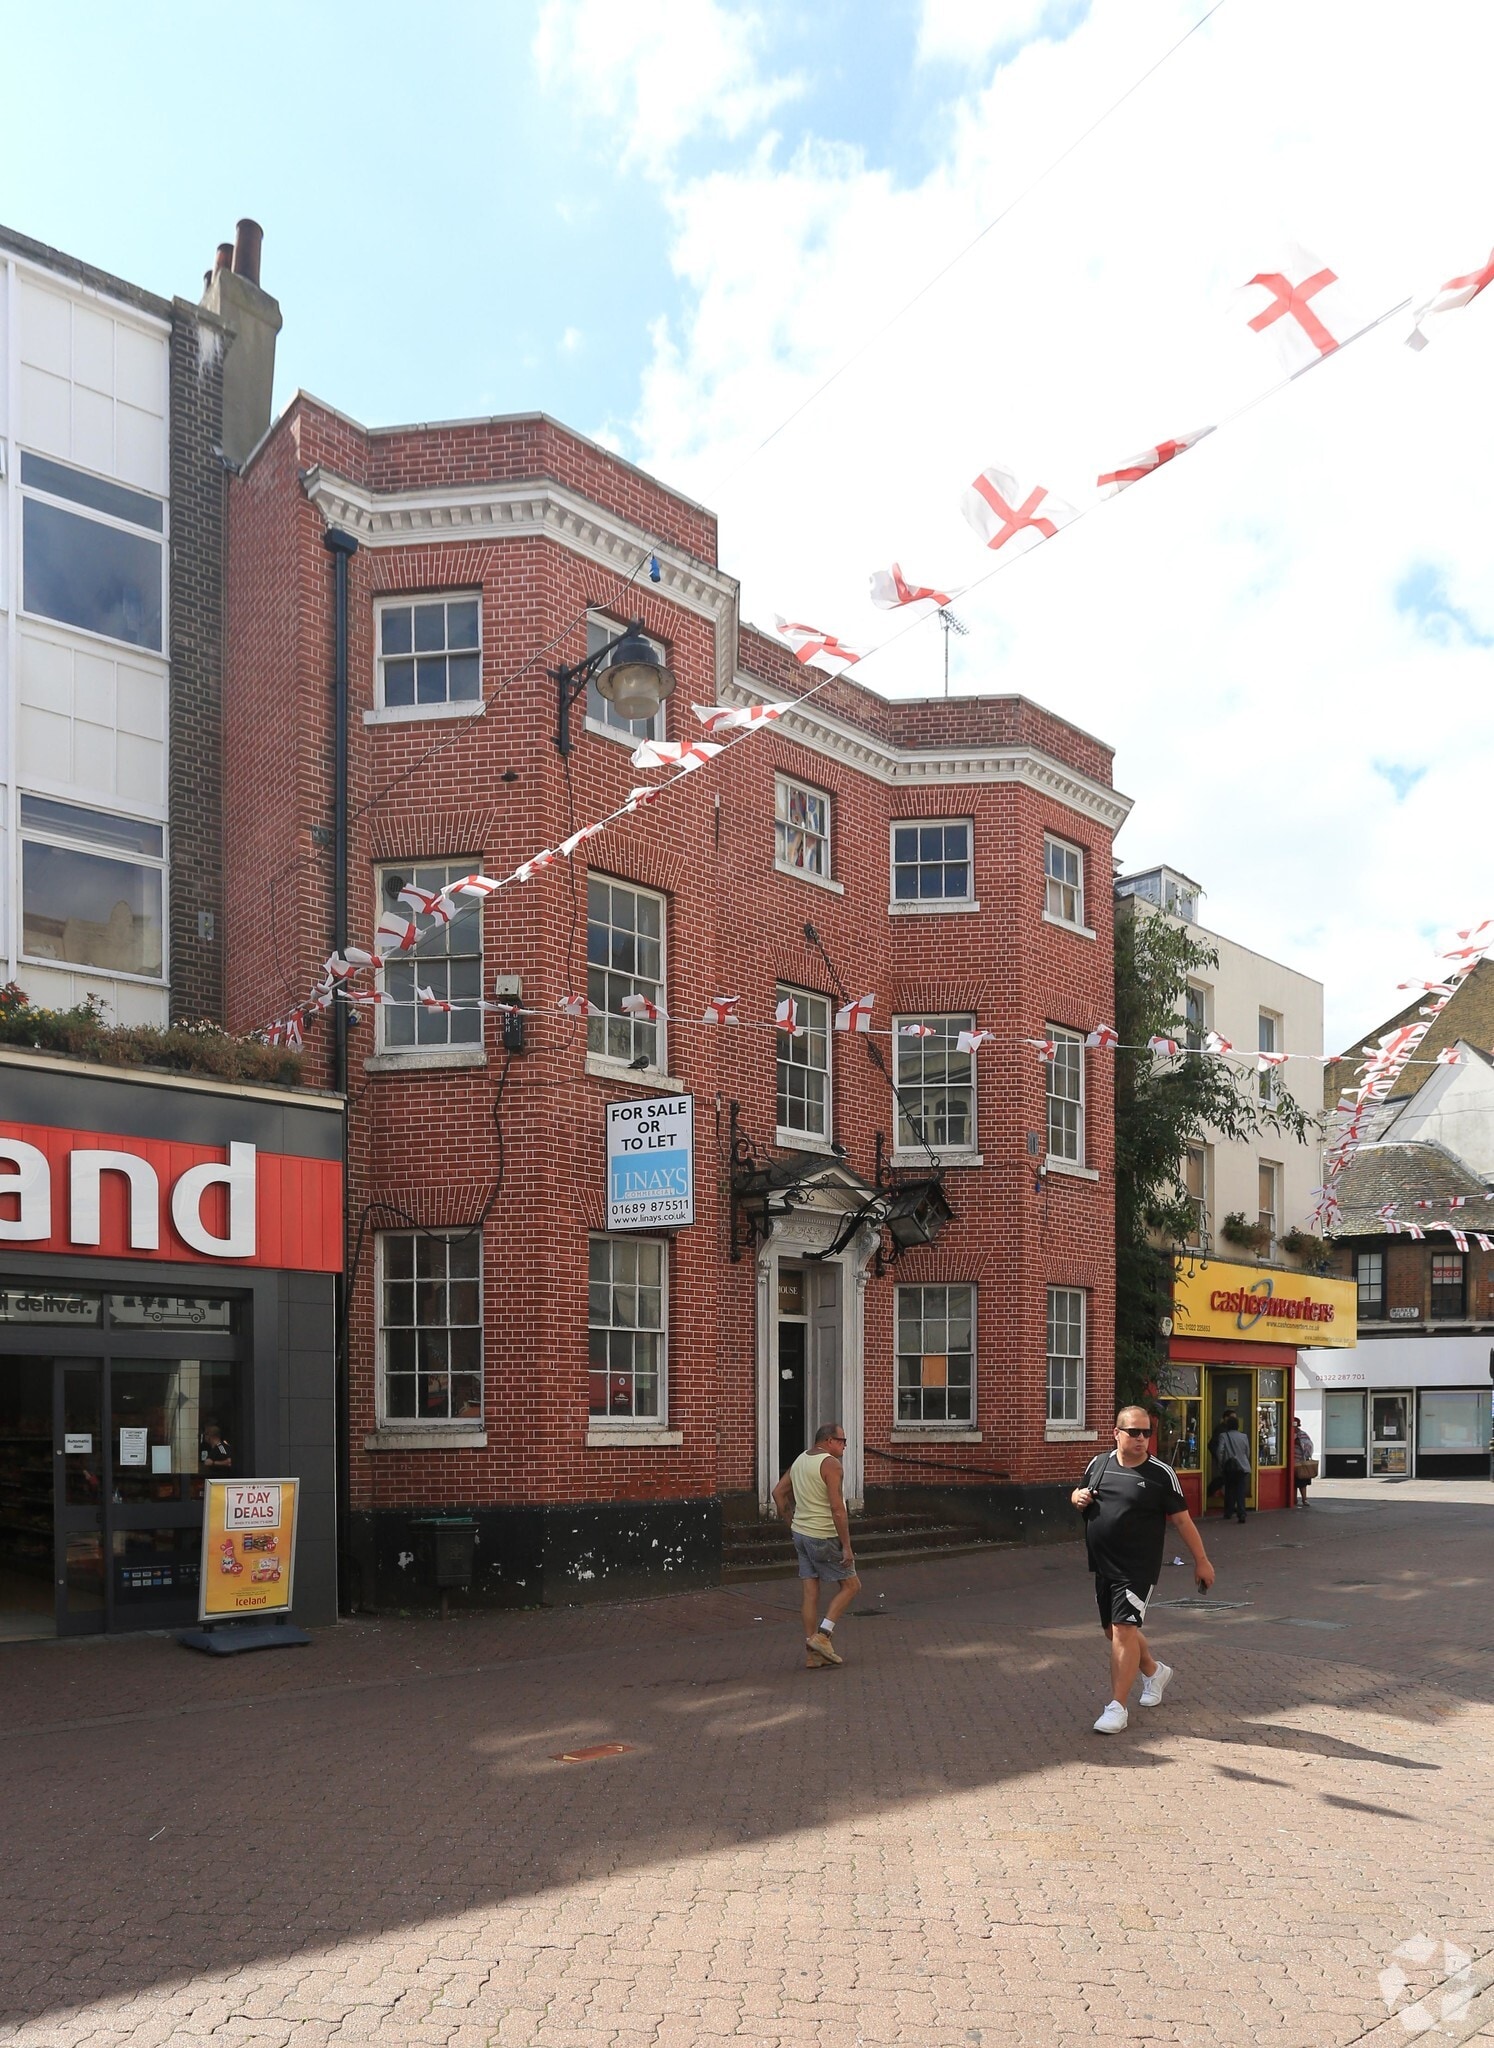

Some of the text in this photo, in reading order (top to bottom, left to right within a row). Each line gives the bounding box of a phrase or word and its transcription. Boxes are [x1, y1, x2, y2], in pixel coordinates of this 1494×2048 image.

[612, 1102, 686, 1122] FOR SALE
[638, 1121, 660, 1133] OR
[621, 1133, 677, 1150] TO LET
[613, 1168, 687, 1200] LINAYS
[625, 1188, 674, 1198] COMMERCIAL
[612, 1199, 689, 1215] 01689 875511
[614, 1212, 686, 1223] www.linays.co.uk
[15, 1293, 93, 1315] deliver.
[236, 1492, 271, 1504] 7 DAY
[234, 1506, 274, 1519] DEALS
[236, 1596, 266, 1606] Iceland
